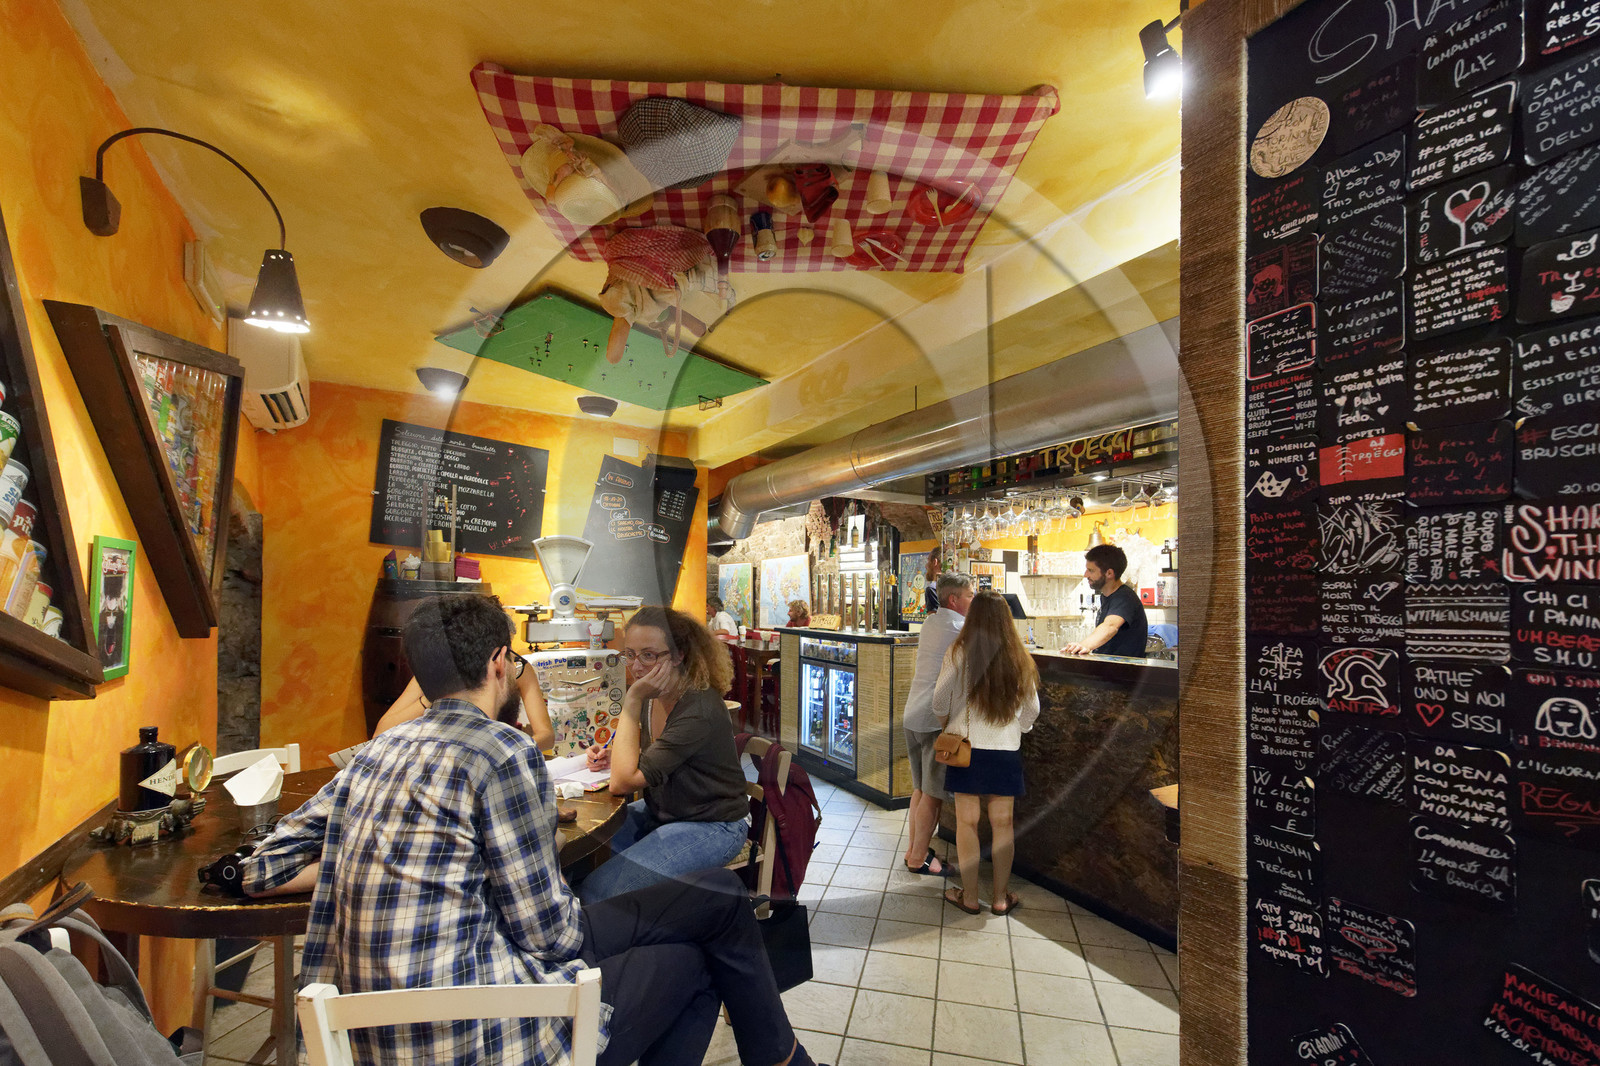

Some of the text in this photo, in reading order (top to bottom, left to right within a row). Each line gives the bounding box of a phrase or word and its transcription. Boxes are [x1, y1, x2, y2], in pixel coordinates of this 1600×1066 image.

[1418, 98, 1488, 128] CONDIVIDI
[1325, 290, 1396, 316] VICTORIA
[1328, 306, 1399, 333] CONCORDIA
[1517, 343, 1542, 358] LA
[1247, 430, 1269, 439] SELFIE
[1249, 459, 1260, 468] DA
[1268, 454, 1303, 464] NUMERI
[1523, 590, 1558, 606] CHI
[1321, 614, 1350, 624] MARE
[1414, 686, 1447, 701] UNO
[1477, 691, 1505, 707] NOI
[1451, 711, 1501, 734] SISSI
[1434, 746, 1456, 758] DA
[1414, 756, 1508, 784] MODENA
[1281, 775, 1306, 791] LA
[1414, 774, 1448, 788] CON
[1253, 786, 1310, 804] IL CIELO
[1255, 798, 1308, 817] IL BUCO
